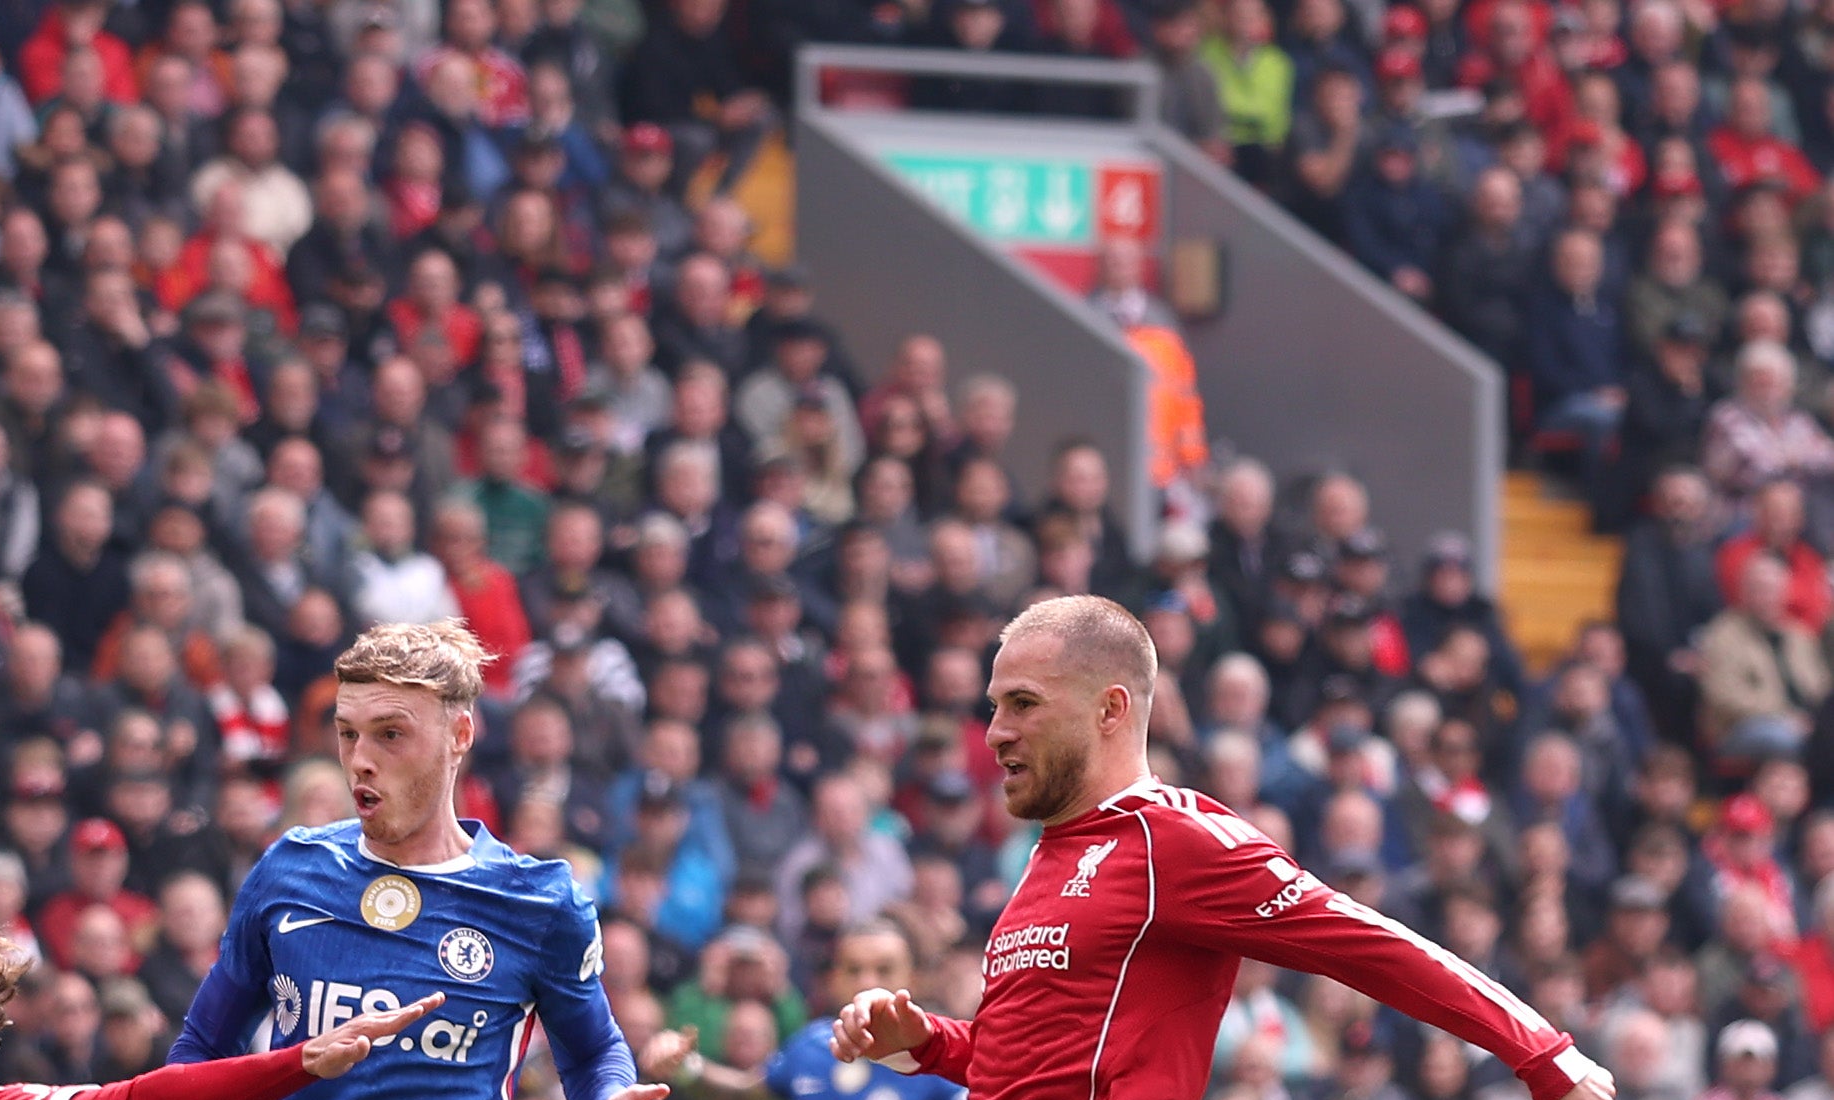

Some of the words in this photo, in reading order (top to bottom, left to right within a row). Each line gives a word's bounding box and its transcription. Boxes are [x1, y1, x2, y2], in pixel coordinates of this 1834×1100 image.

[1060, 883, 1091, 898] LFC
[373, 916, 397, 928] FIFA
[991, 922, 1070, 956] standard
[989, 946, 1070, 978] chartered
